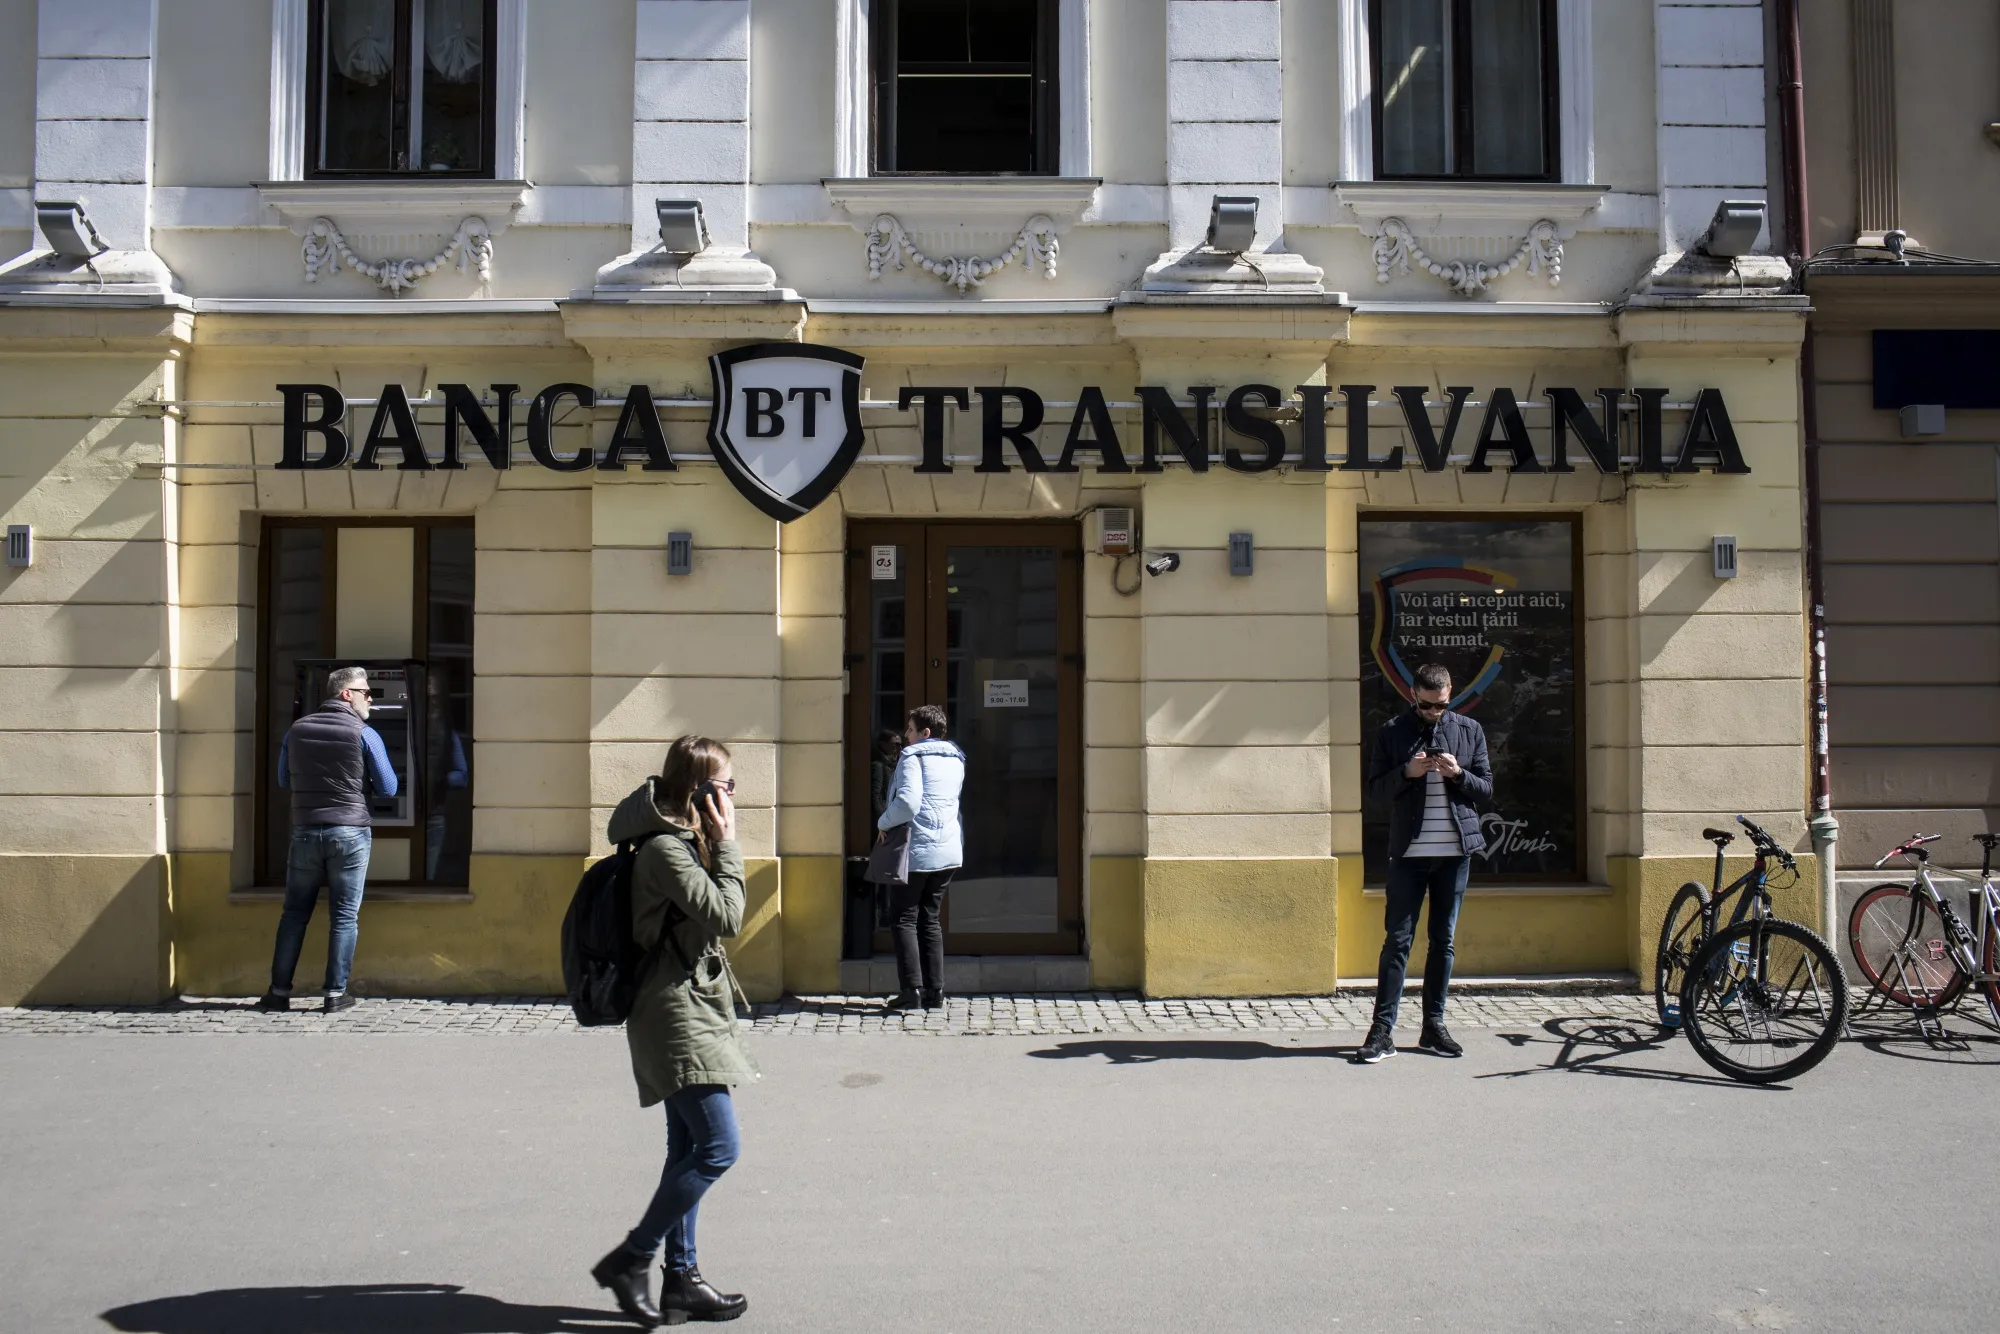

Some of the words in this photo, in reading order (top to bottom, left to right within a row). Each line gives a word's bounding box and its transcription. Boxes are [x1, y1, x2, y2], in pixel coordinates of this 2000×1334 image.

[276, 383, 679, 472] BANCA
[741, 388, 831, 438] BT
[898, 383, 1752, 475] TRANSILVANIA
[1106, 533, 1127, 542] DSC
[1399, 592, 1428, 608] Voi
[1432, 592, 1455, 612] ați
[1459, 592, 1526, 611] început
[1529, 592, 1566, 609] aici,
[1399, 612, 1424, 627] iar
[1428, 612, 1478, 627] restul
[1481, 611, 1519, 632] țării
[1399, 634, 1427, 647] v-a
[1431, 632, 1490, 647] urmat.
[1489, 819, 1557, 855] Timi
